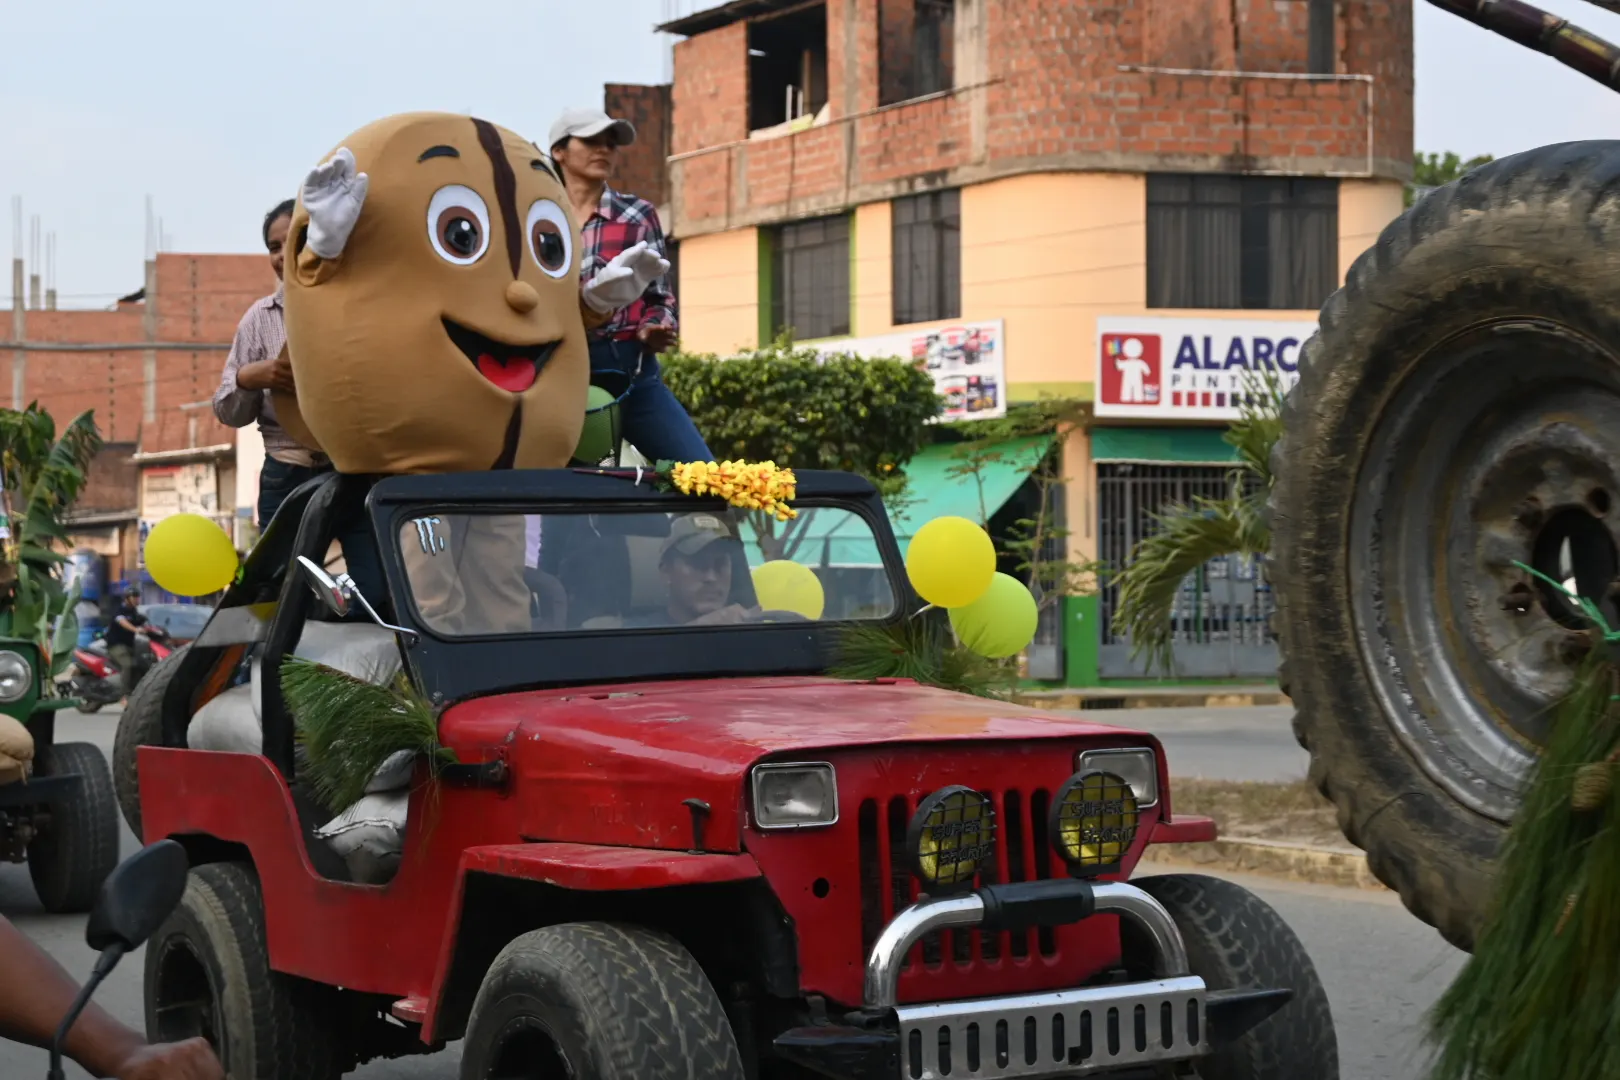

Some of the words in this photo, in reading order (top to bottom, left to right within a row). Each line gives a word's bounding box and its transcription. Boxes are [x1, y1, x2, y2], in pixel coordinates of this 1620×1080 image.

[1172, 335, 1299, 372] ALARC
[1071, 800, 1124, 817] SUPER
[932, 819, 981, 840] SUPER
